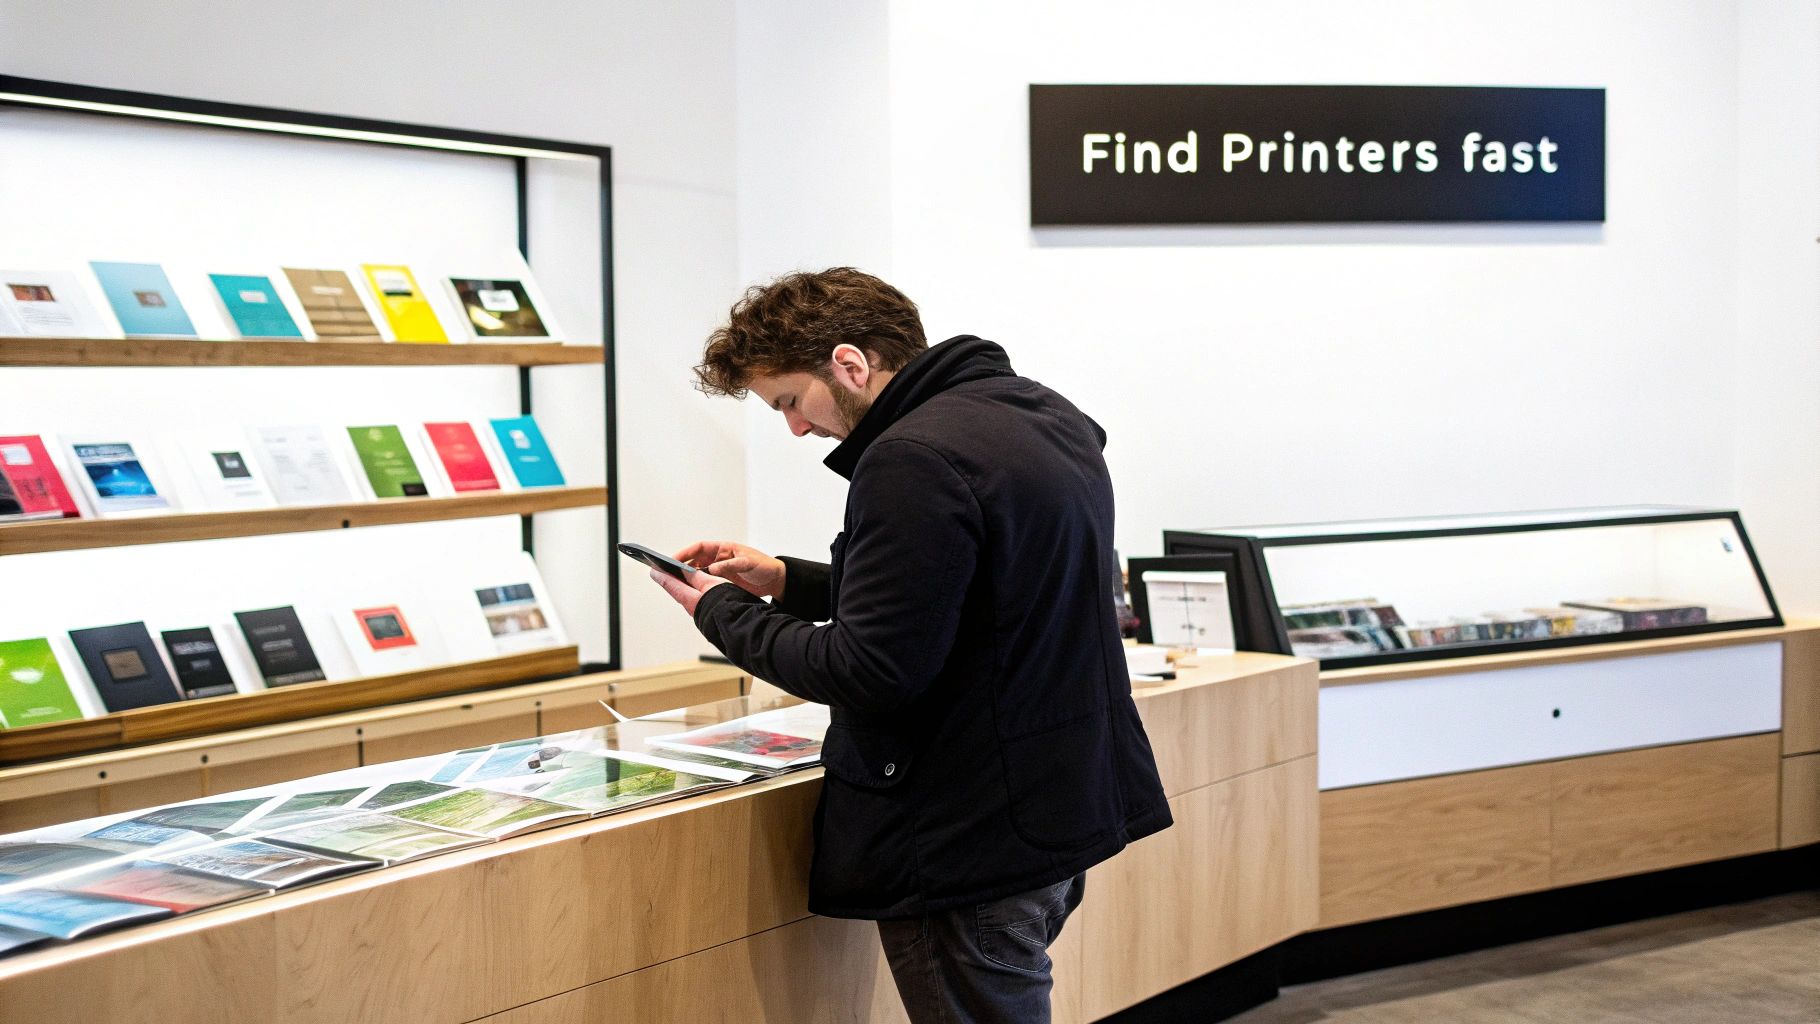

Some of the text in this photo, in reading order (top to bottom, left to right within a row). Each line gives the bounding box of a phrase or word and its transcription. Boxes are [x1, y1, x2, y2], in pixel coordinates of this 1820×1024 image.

[1083, 130, 1558, 174] Find Printers fast
